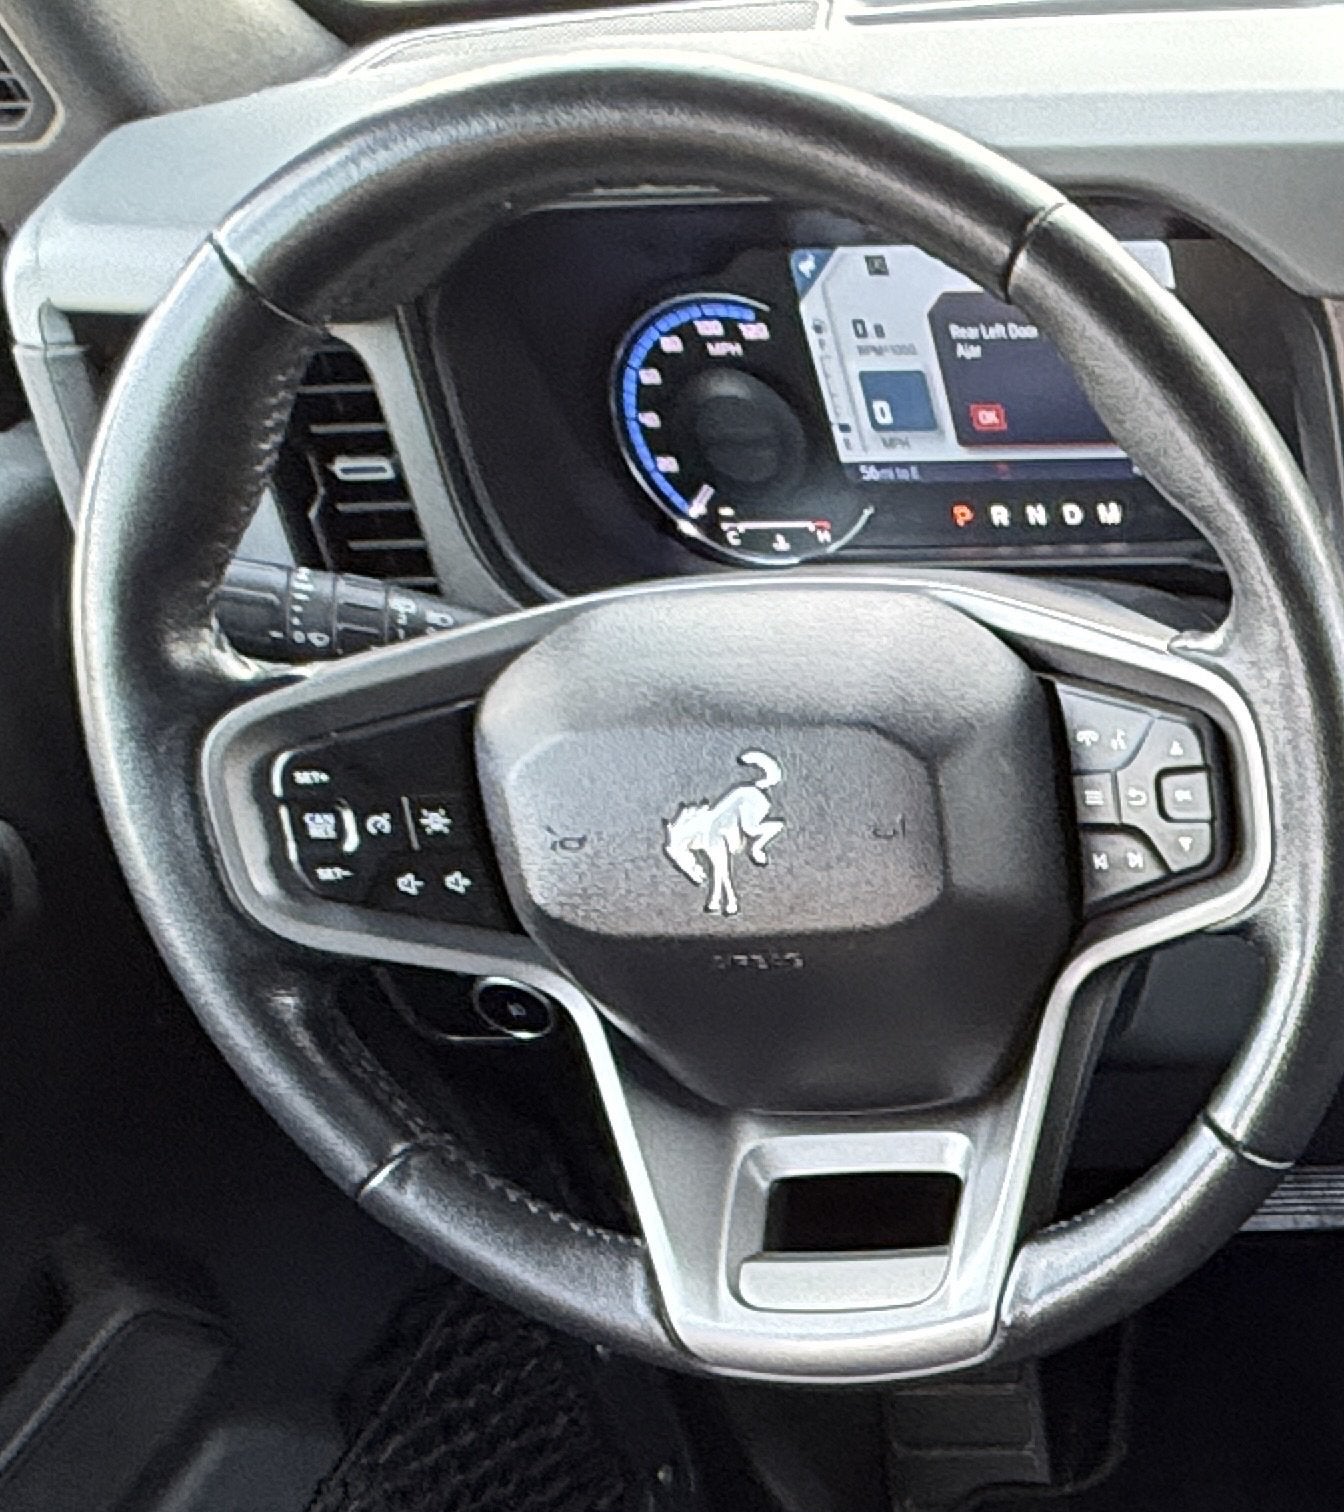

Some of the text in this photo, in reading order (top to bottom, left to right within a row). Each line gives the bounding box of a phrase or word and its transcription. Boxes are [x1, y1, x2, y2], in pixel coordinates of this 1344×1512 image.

[950, 322, 980, 339] Rear
[980, 322, 1008, 340] Left
[872, 400, 893, 425] 0
[952, 502, 1122, 527] P R N D M
